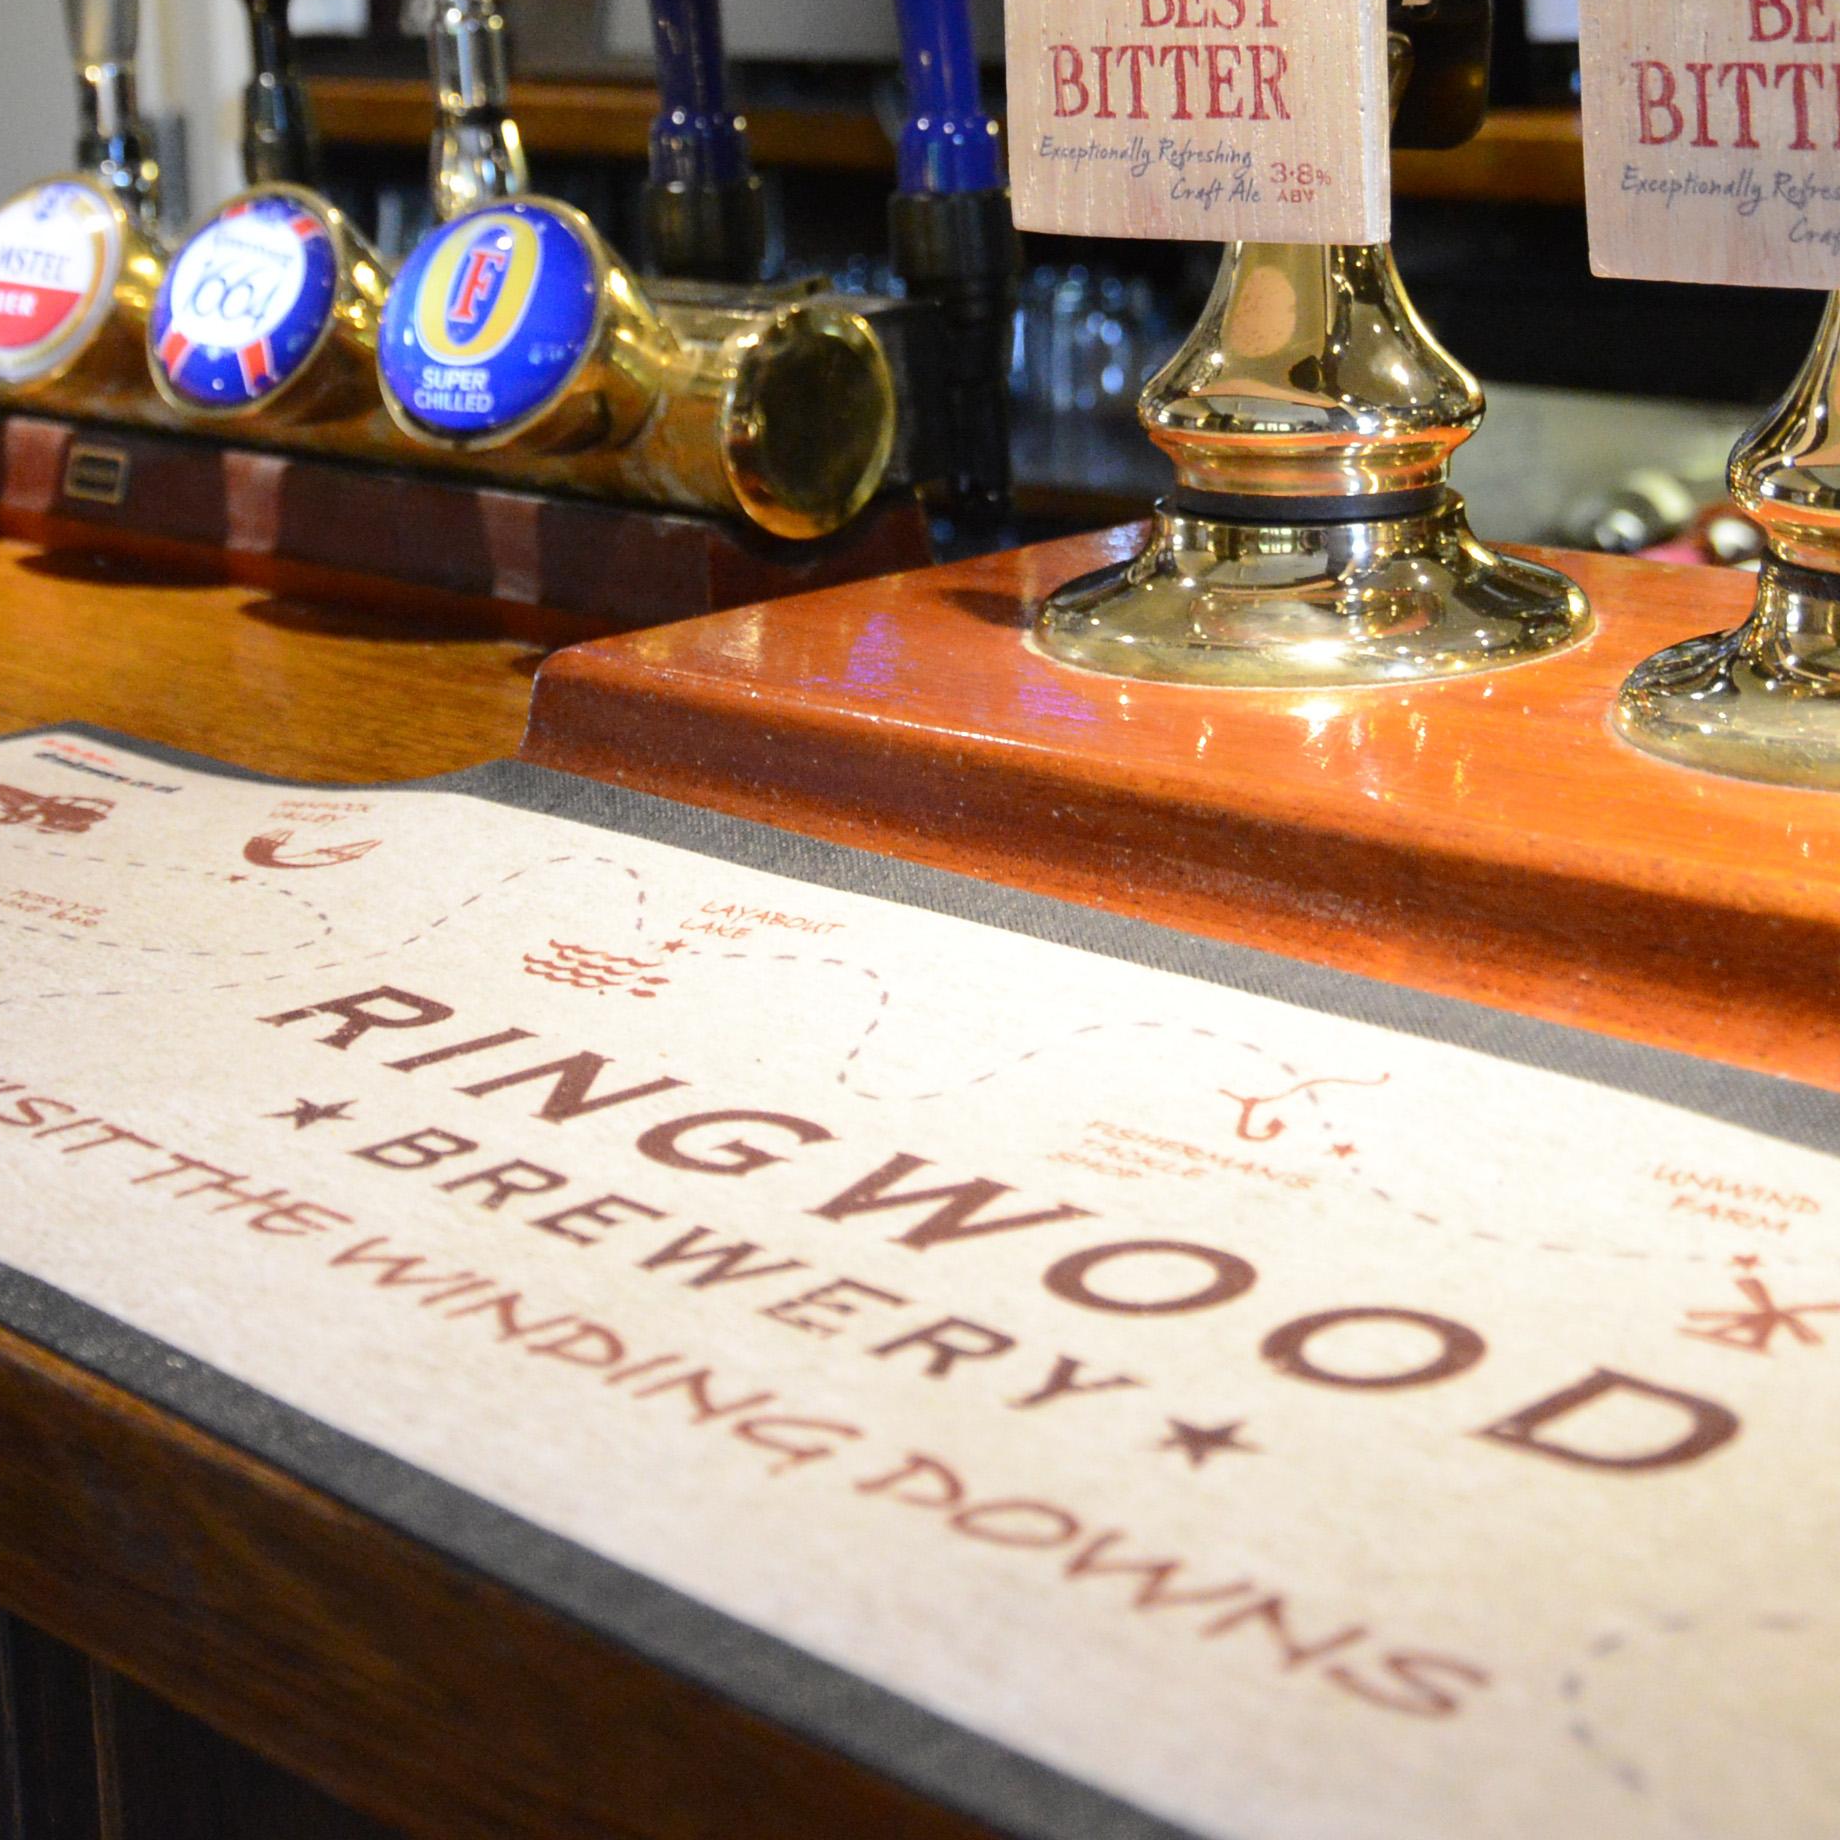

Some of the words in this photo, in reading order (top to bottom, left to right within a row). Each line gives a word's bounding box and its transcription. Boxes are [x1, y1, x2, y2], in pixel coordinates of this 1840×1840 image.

[1050, 44, 1291, 121] BITTER
[1039, 135, 1152, 172] Exceptionally
[1159, 137, 1254, 171] Refreshing
[1170, 176, 1222, 205] Craft
[1228, 177, 1261, 204] Ale
[1277, 189, 1316, 204] ABV
[1621, 164, 1764, 213] Exceptionally
[421, 366, 490, 392] SUPER
[413, 388, 495, 413] CHILLED
[679, 918, 753, 940] LAKE
[700, 900, 847, 934] LAYABOUT
[1081, 1138, 1207, 1178] TACKLE
[1086, 1120, 1318, 1189] FISHERMAN'S
[1637, 1162, 1821, 1214] UNWIND
[255, 985, 1743, 1477] RINGWOOD
[1670, 1194, 1790, 1235] FARM
[348, 1126, 1148, 1412] BREWERY
[130, 1153, 355, 1236] THE
[328, 1235, 865, 1477] WINDING
[854, 1451, 1491, 1721] DOWNS
